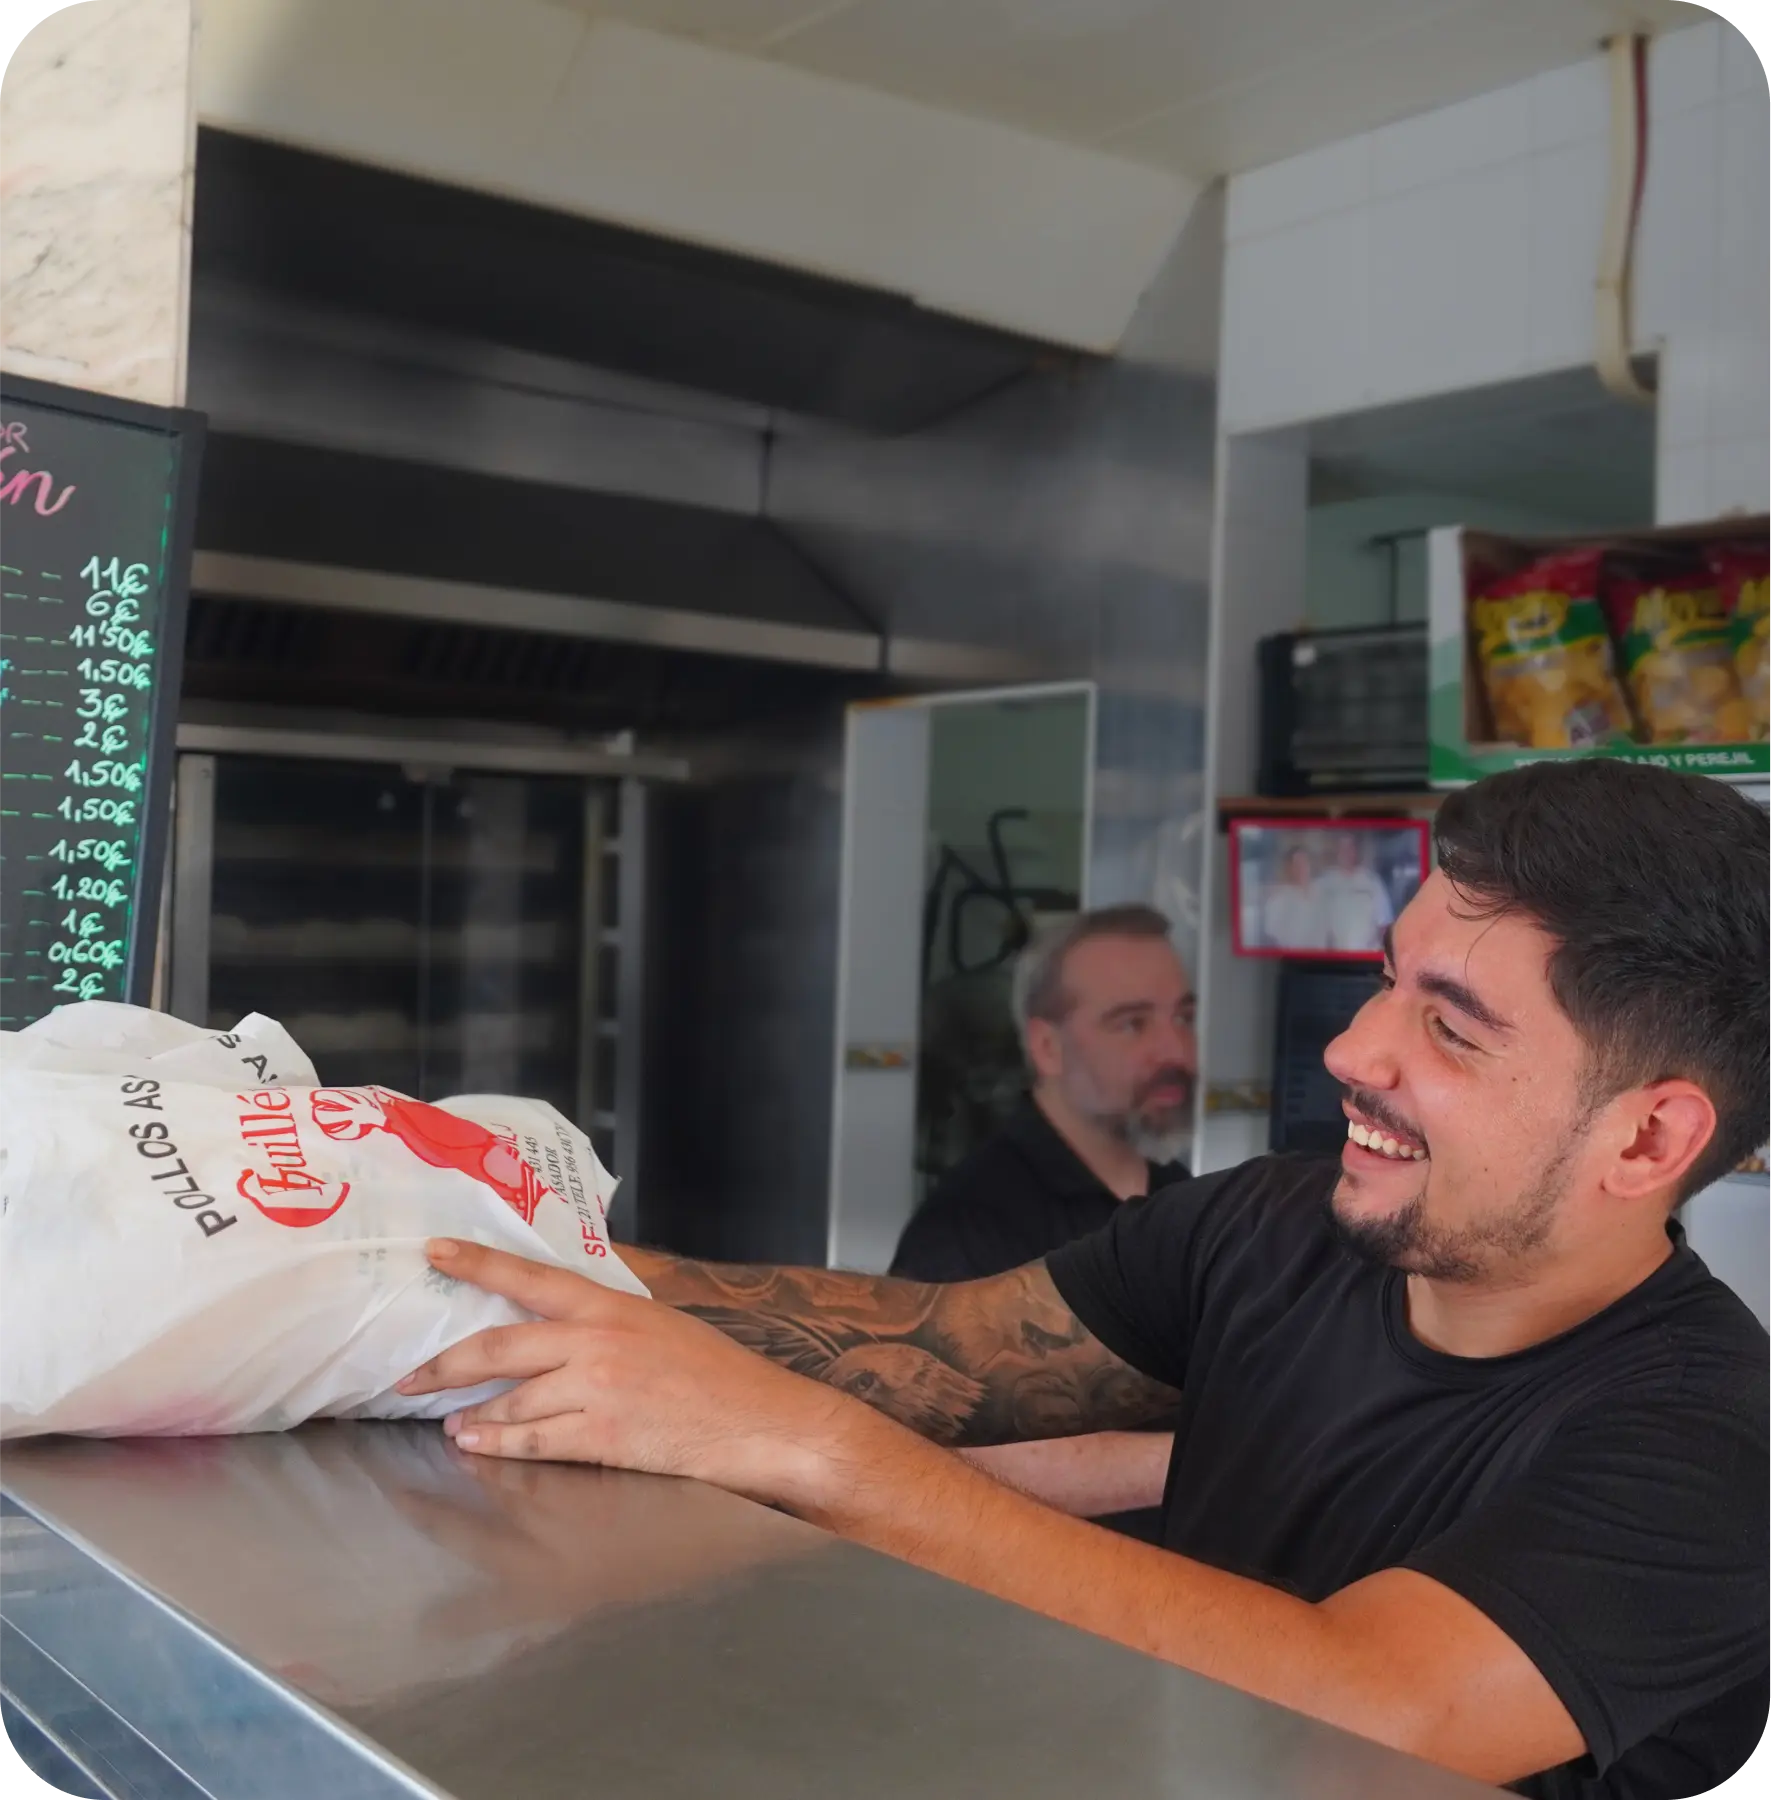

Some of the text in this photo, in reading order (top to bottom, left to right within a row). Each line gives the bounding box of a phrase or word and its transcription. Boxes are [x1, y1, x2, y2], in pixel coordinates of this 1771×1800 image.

[80, 555, 149, 596] 11€
[77, 657, 151, 690] 1,50€
[76, 688, 129, 723] 3€
[73, 721, 129, 755] 2€
[64, 759, 143, 791] 1,50€
[1670, 753, 1682, 766] Y
[57, 795, 136, 826] 1,50€
[48, 839, 132, 872] 1,50€
[51, 874, 129, 908] 1,20€
[48, 939, 124, 970] 0,60€
[120, 1073, 238, 1238] POLLOS AS
[543, 1145, 568, 1197] ASADOR
